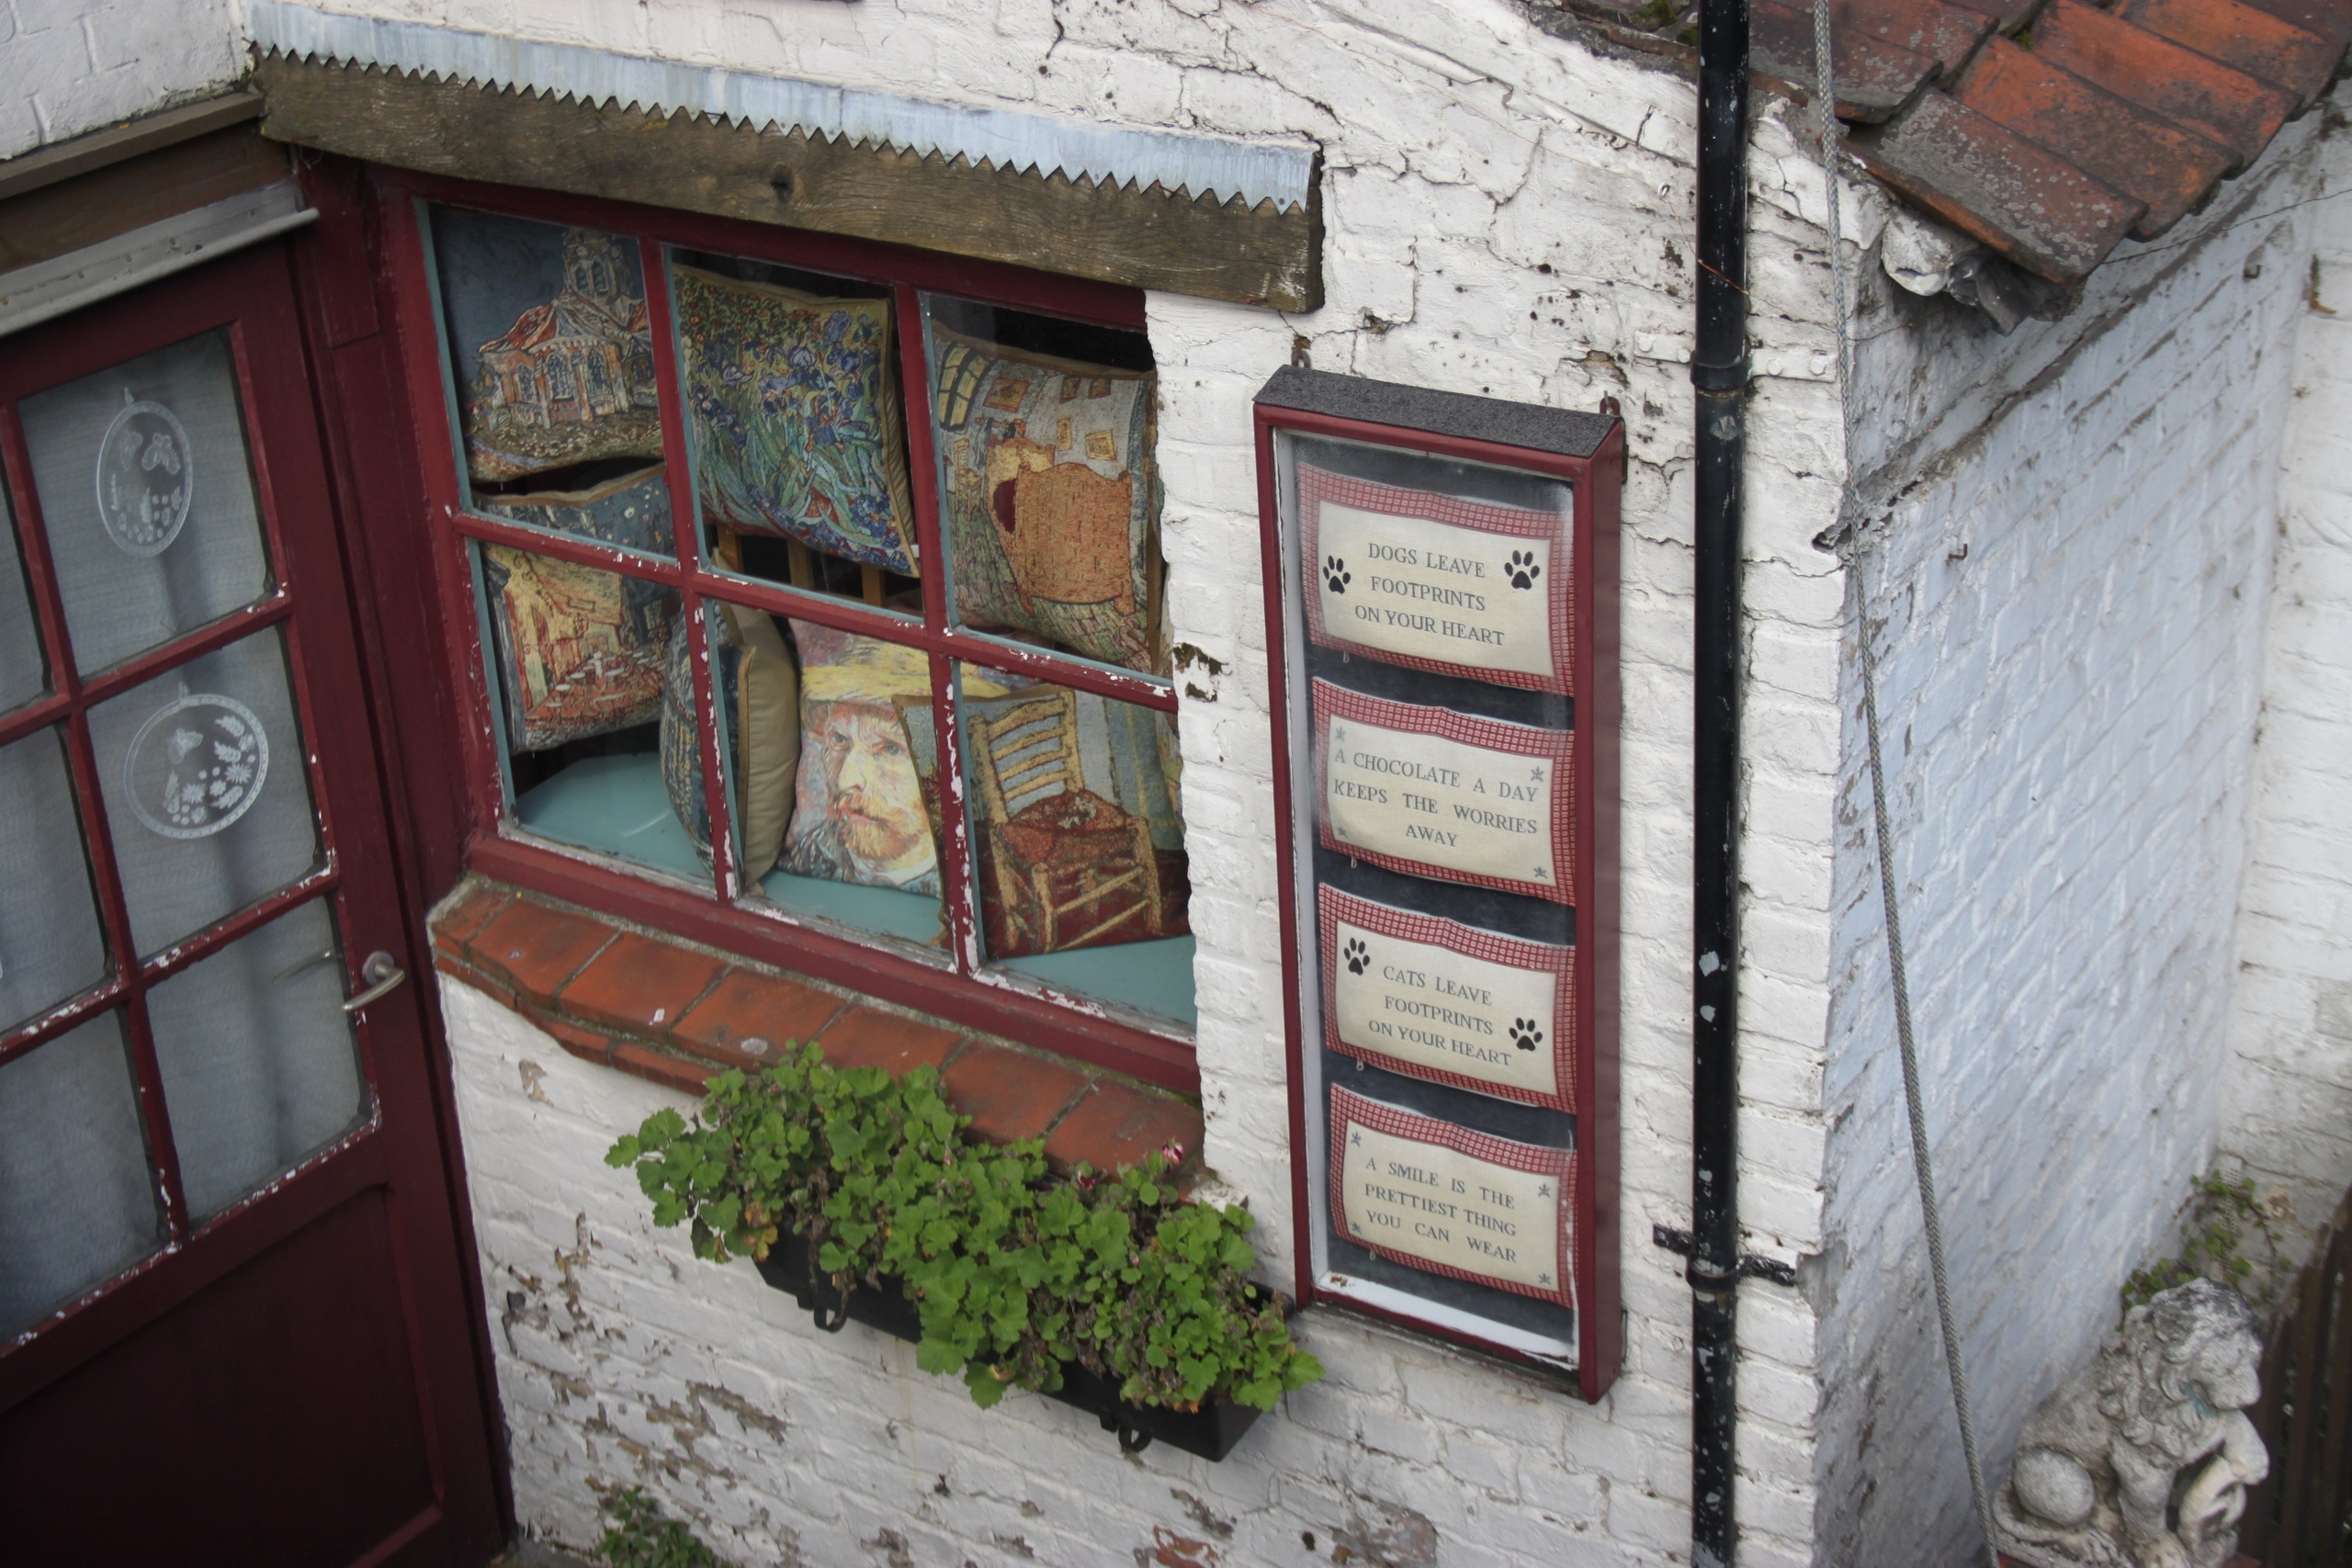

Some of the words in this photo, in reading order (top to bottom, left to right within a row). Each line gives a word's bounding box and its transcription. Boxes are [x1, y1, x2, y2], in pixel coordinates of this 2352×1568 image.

[1368, 543, 1417, 567] DOGS
[1426, 551, 1486, 579] LEAVE
[1371, 576, 1486, 612] FOOTPRINTS
[1355, 605, 1380, 623] ON
[1385, 611, 1436, 634] YOUR
[1442, 621, 1504, 647] HEART
[1335, 749, 1346, 765] A
[1353, 752, 1460, 788] CHOCOLATE
[1473, 779, 1486, 794] A
[1498, 782, 1538, 803] DAY
[1334, 781, 1387, 804] KEEPS
[1403, 794, 1438, 813] THE
[1453, 805, 1537, 834] WORRIES
[1406, 824, 1457, 848] AWAY
[1384, 965, 1426, 988] CATS
[1435, 977, 1491, 1006] LEAVE
[1385, 997, 1493, 1034] FOOTPRINTS
[1369, 1020, 1393, 1038] ON
[1397, 1026, 1446, 1049] YOUR
[1452, 1041, 1511, 1066] HEART
[1365, 1156, 1377, 1171] A
[1388, 1162, 1439, 1186] SMILE
[1452, 1179, 1465, 1193] IS
[1479, 1187, 1515, 1209] THE
[1365, 1184, 1458, 1219] PRETTIEST
[1464, 1210, 1516, 1236] THING
[1366, 1210, 1401, 1229] YOU
[1415, 1223, 1451, 1243] CAN
[1466, 1235, 1517, 1262] WEAR
